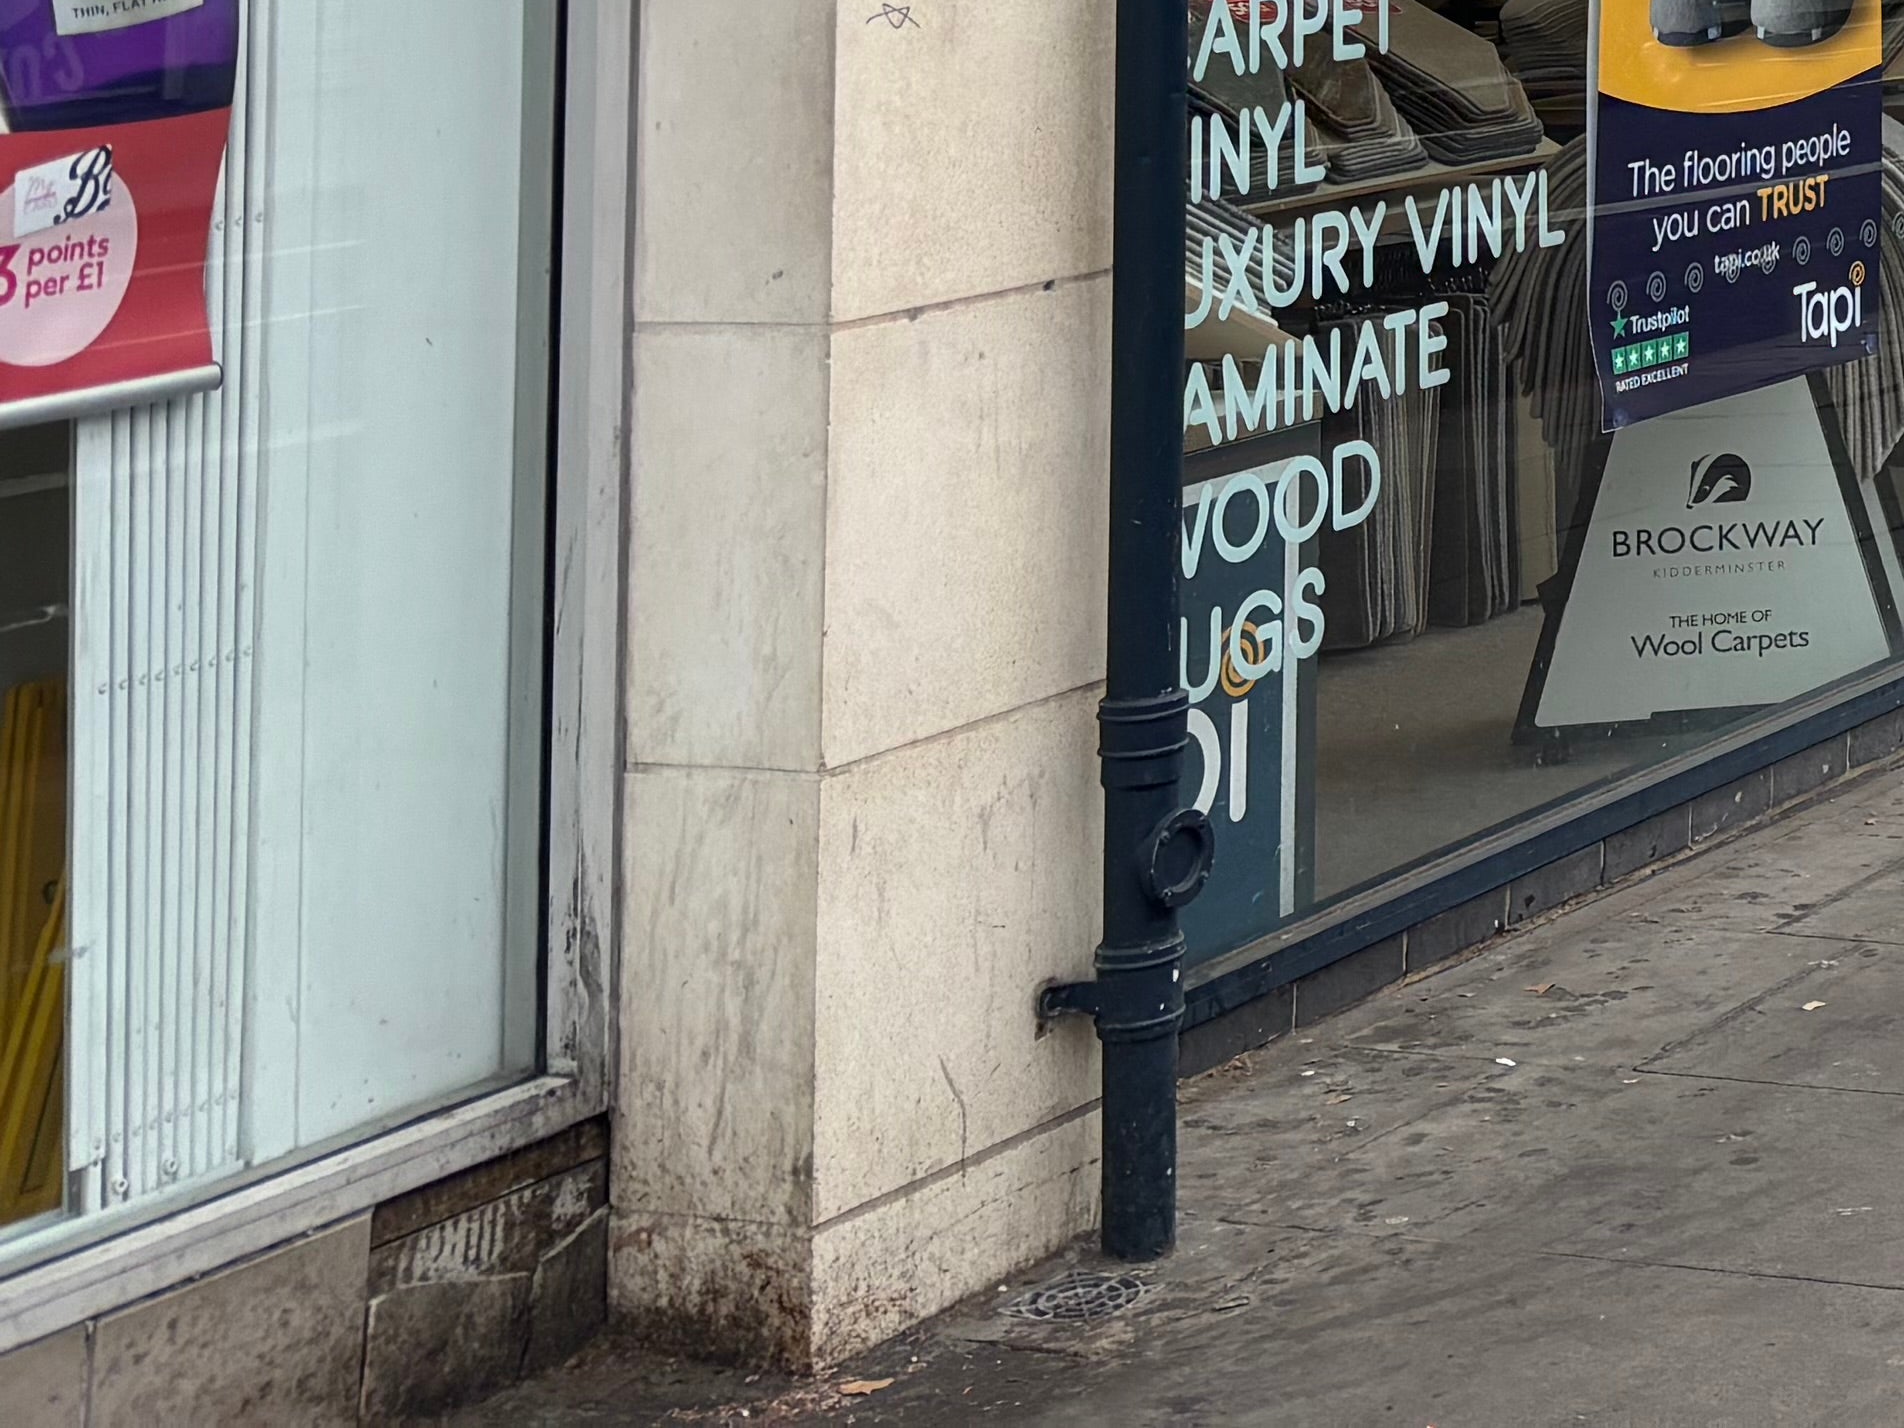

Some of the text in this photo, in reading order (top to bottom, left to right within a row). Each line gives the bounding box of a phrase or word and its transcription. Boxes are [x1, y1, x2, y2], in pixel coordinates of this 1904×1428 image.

[73, 5, 110, 20] THIN,
[1190, 100, 1326, 205] INYL
[1627, 123, 1851, 198] The flooring people
[1652, 174, 1829, 252] you can TRUST
[26, 235, 109, 276] points
[1184, 169, 1565, 329] UXURY VINYL
[1714, 241, 1780, 276] tapi.co.uk
[25, 261, 104, 309] per £1
[1792, 260, 1865, 348] Tapi
[1629, 305, 1690, 334] Trustpilot
[1183, 300, 1450, 447] AMINATE
[1615, 363, 1689, 393] RATED EXCELLENT
[1612, 517, 1825, 558] BROCKWAY
[1653, 559, 1786, 579] KIDDERMINSTER
[1180, 566, 1325, 702] UGS
[1669, 609, 1773, 628] THE HOME OF
[1631, 627, 1810, 658] Wool Carpets
